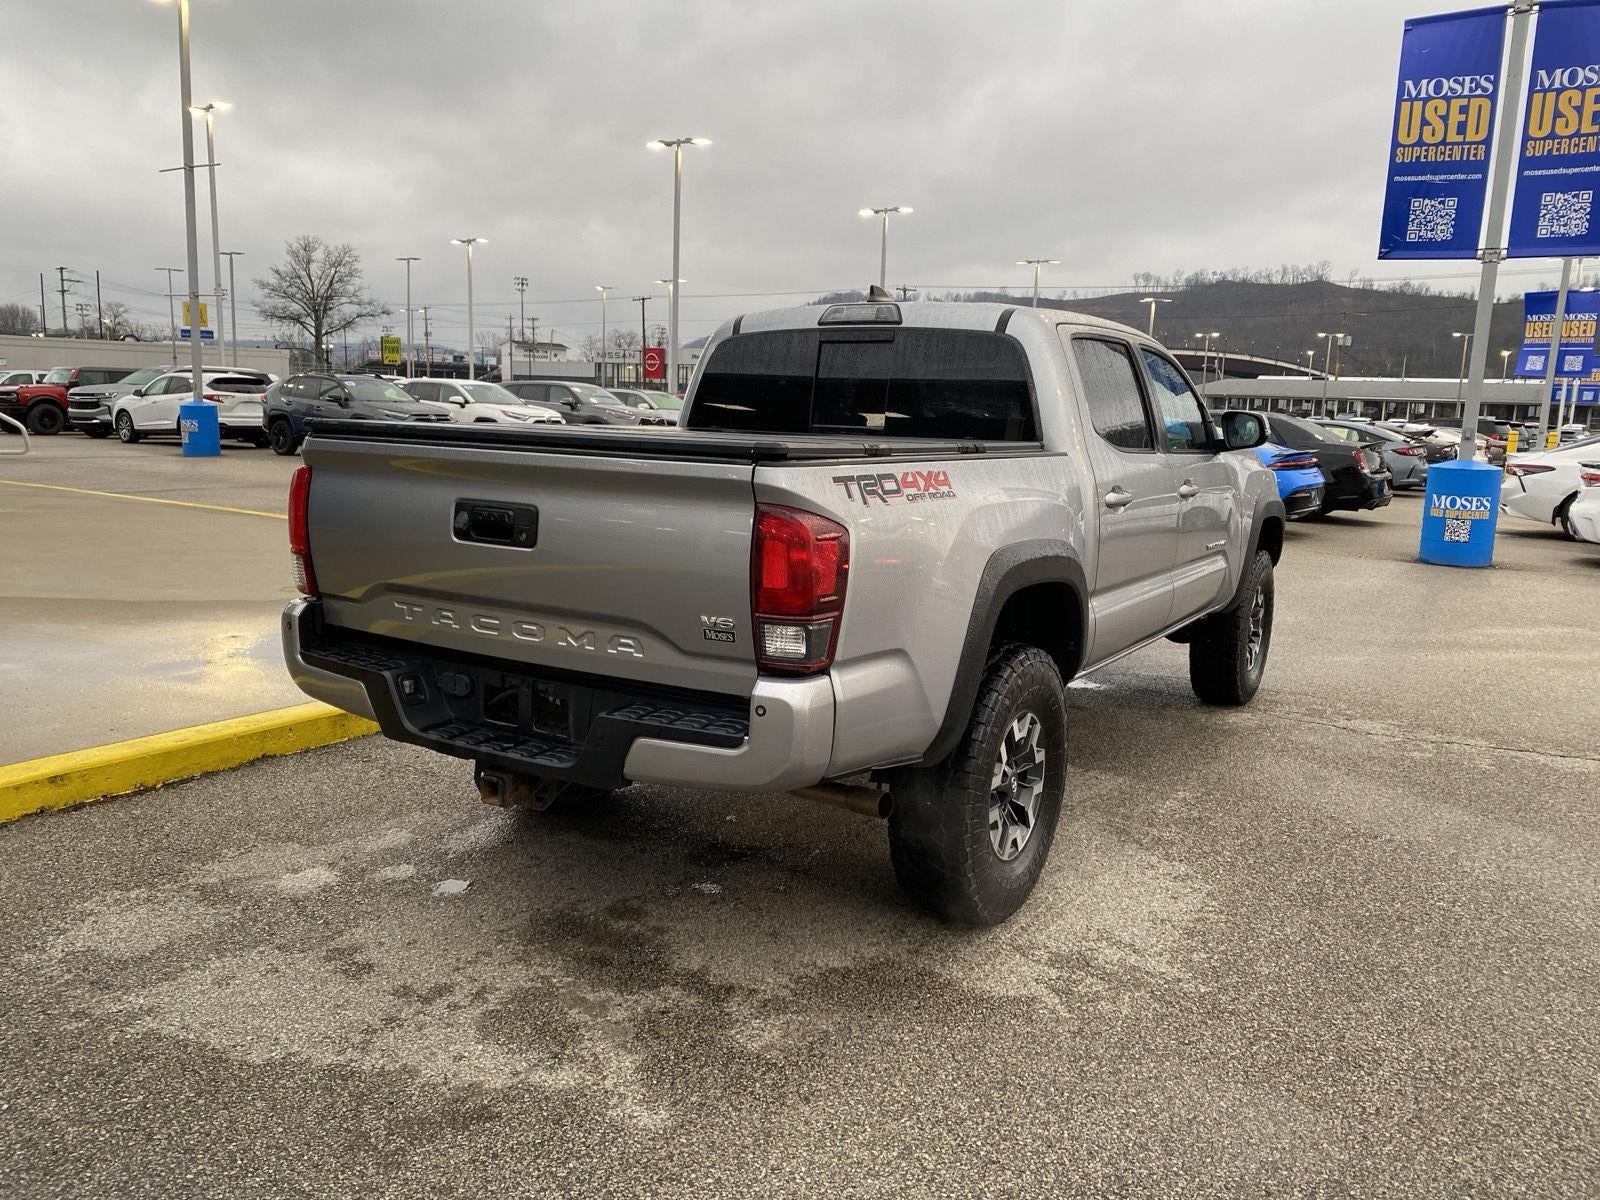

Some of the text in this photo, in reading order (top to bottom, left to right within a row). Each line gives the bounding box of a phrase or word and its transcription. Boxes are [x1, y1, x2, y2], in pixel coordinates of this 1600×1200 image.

[1535, 64, 1600, 90] MOS
[1403, 75, 1494, 99] MOSES
[1397, 97, 1491, 145] USED
[1395, 145, 1486, 163] SUPERCENTER
[1526, 135, 1600, 157] SUPERCEN
[1394, 173, 1482, 182] mosesusedsupercenter.com
[1563, 312, 1598, 320] MOSES
[1561, 320, 1596, 337] USED
[597, 351, 636, 359] NISSAN
[832, 473, 904, 508] TRD
[928, 490, 957, 501] ROAD
[1431, 494, 1491, 511] MOSES
[392, 601, 645, 657] TACOMA
